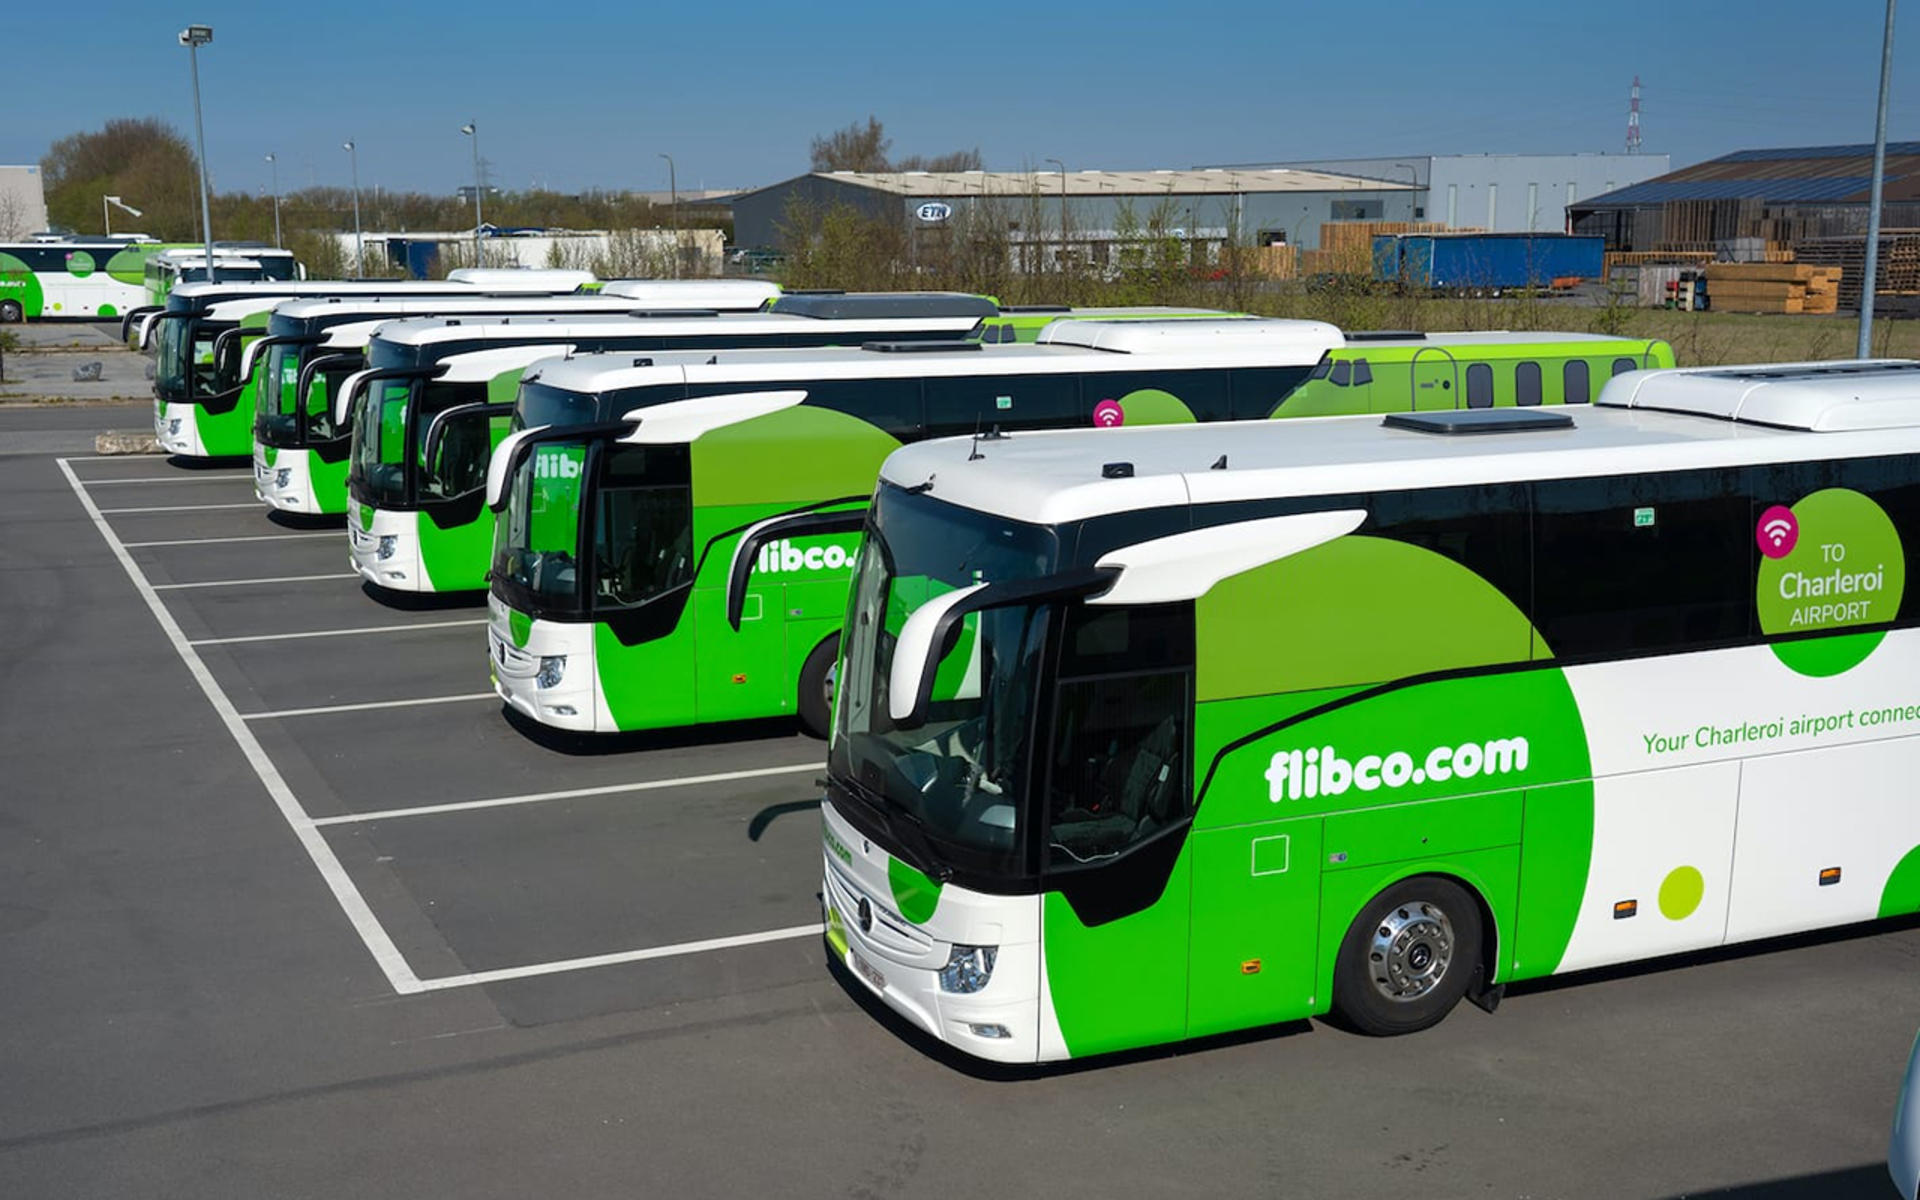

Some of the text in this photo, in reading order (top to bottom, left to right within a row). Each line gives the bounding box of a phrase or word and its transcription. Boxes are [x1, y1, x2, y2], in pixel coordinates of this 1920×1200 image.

[1821, 543, 1845, 563] TO
[1779, 564, 1883, 600] Charleroi
[1790, 600, 1871, 627] AIRPORT
[1643, 734, 1690, 754] Your
[1696, 717, 1785, 748] Charleroi
[1790, 709, 1855, 737] airport
[1265, 736, 1529, 803] flibco.com
